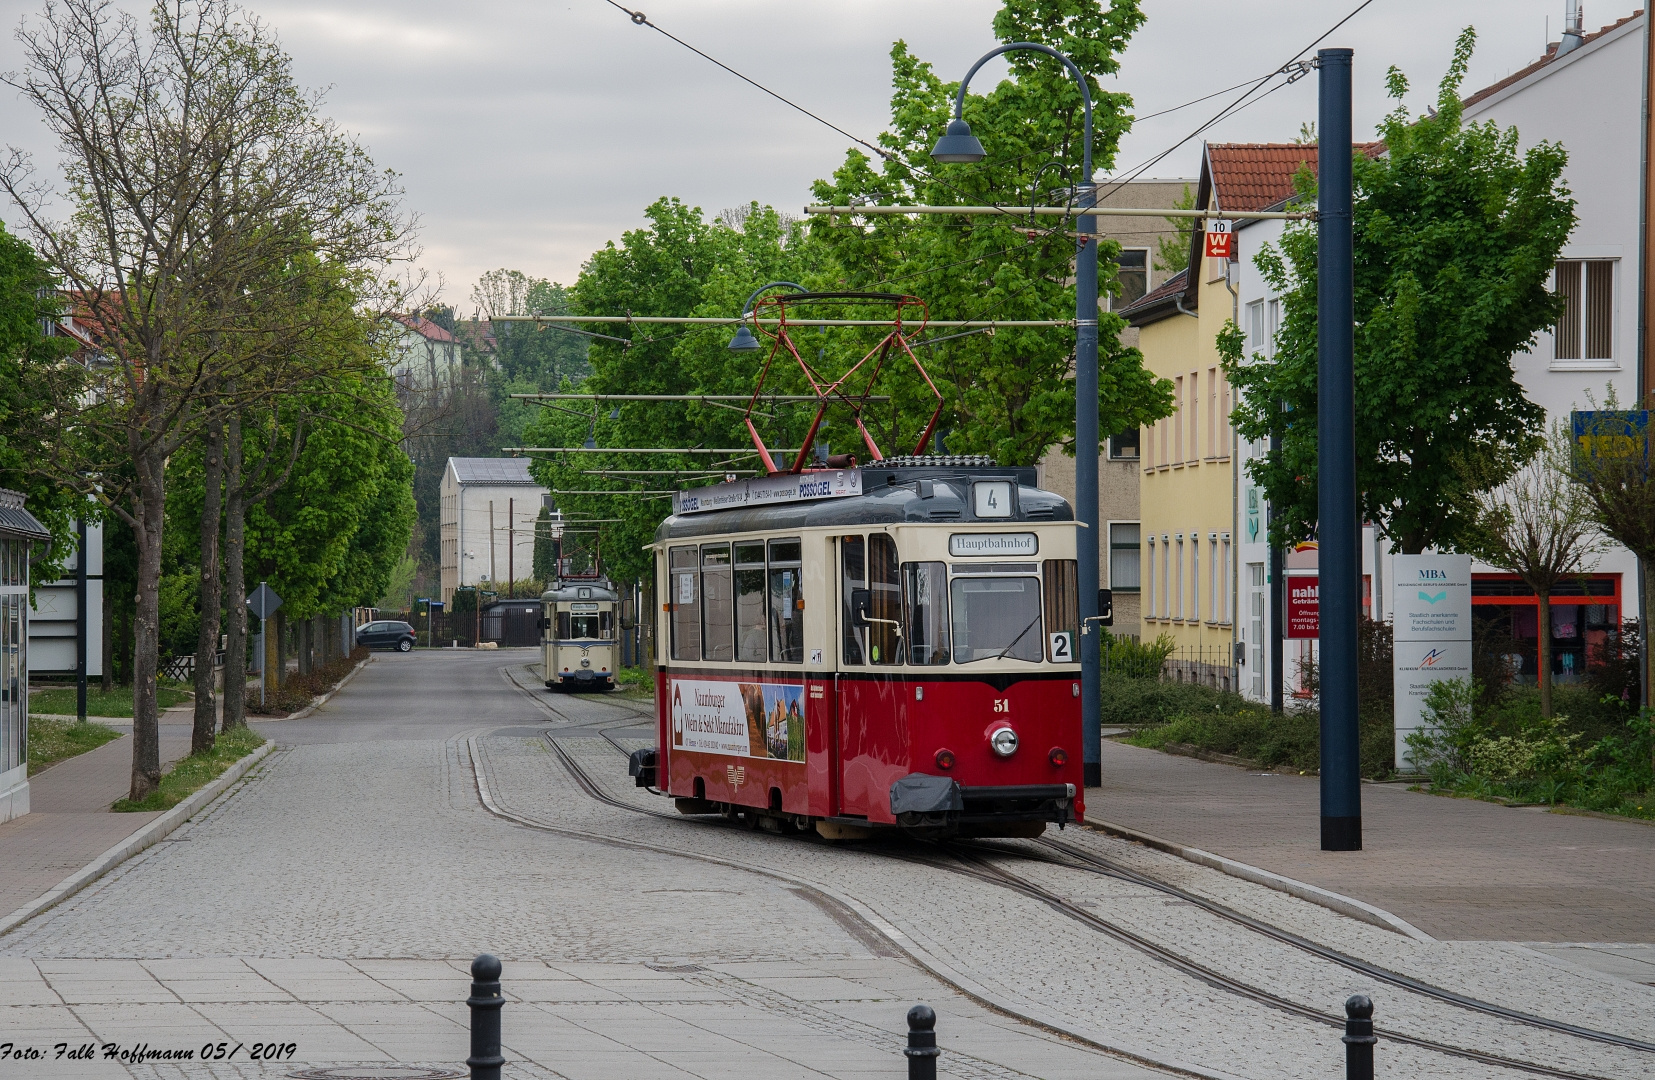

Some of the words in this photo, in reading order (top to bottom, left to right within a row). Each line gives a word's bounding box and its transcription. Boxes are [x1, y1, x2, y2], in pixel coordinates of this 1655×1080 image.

[1213, 223, 1225, 232] 10
[1210, 234, 1227, 246] W
[988, 489, 997, 509] 4
[956, 537, 1031, 550] Hauptbahnhof
[1419, 570, 1447, 579] MBA
[1054, 635, 1068, 656] 2
[581, 649, 589, 657] 37
[694, 688, 725, 714] Naumburger
[993, 699, 1009, 712] 51
[685, 713, 697, 732] Wein
[698, 715, 703, 732] &
[703, 715, 714, 733] Sekt
[715, 716, 744, 736] Manufaktur
